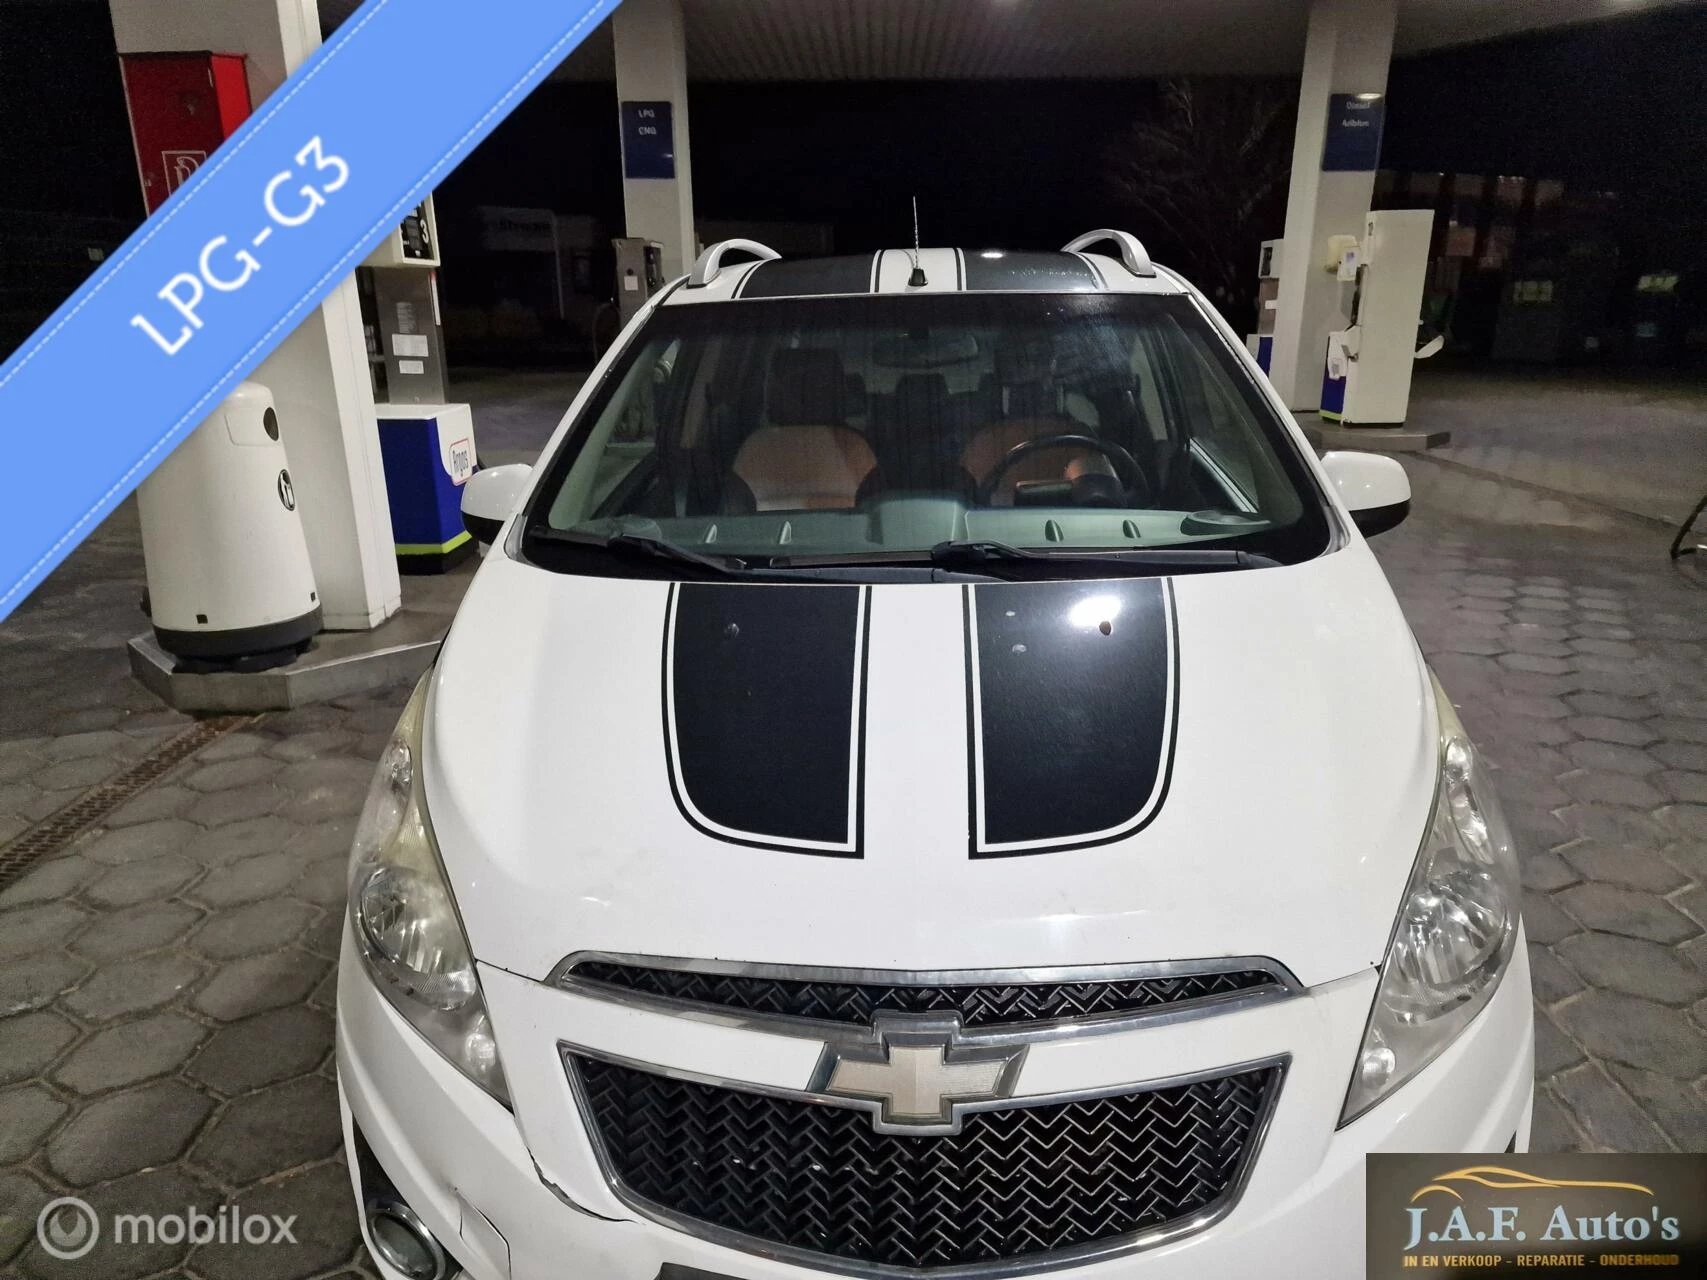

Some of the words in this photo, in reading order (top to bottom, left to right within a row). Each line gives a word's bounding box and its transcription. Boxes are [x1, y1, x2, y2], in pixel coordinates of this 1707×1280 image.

[638, 109, 655, 118] LPG
[638, 126, 657, 135] CNG
[420, 219, 429, 244] 3
